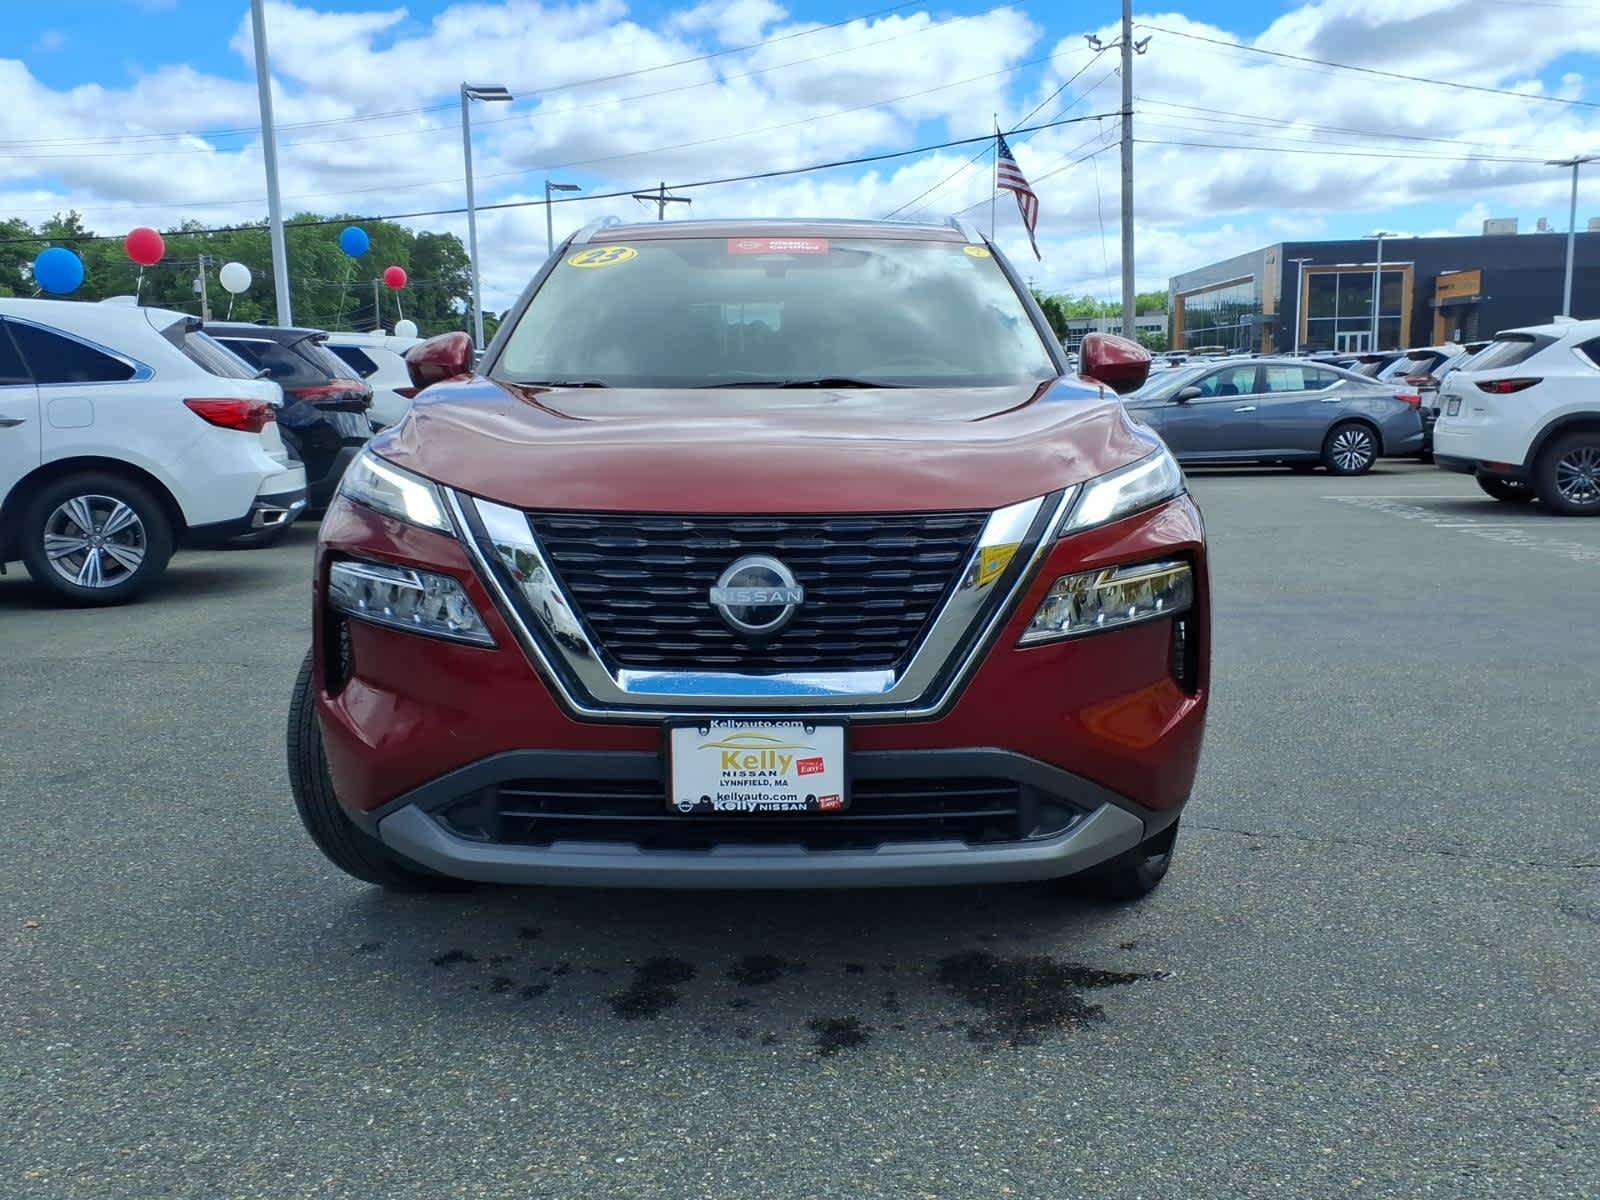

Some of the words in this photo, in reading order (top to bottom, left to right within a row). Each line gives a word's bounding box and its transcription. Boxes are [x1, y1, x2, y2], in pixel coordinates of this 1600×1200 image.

[577, 247, 628, 265] 23
[713, 591, 801, 603] NISSAN
[710, 719, 804, 729] Kellyauto.com
[721, 750, 793, 775] Kelly
[719, 779, 772, 787] LYNNFIELD,
[774, 779, 789, 787] MA
[717, 792, 798, 802] kellyauto.com
[713, 800, 757, 813] Kelly
[759, 803, 808, 811] NISSAN
